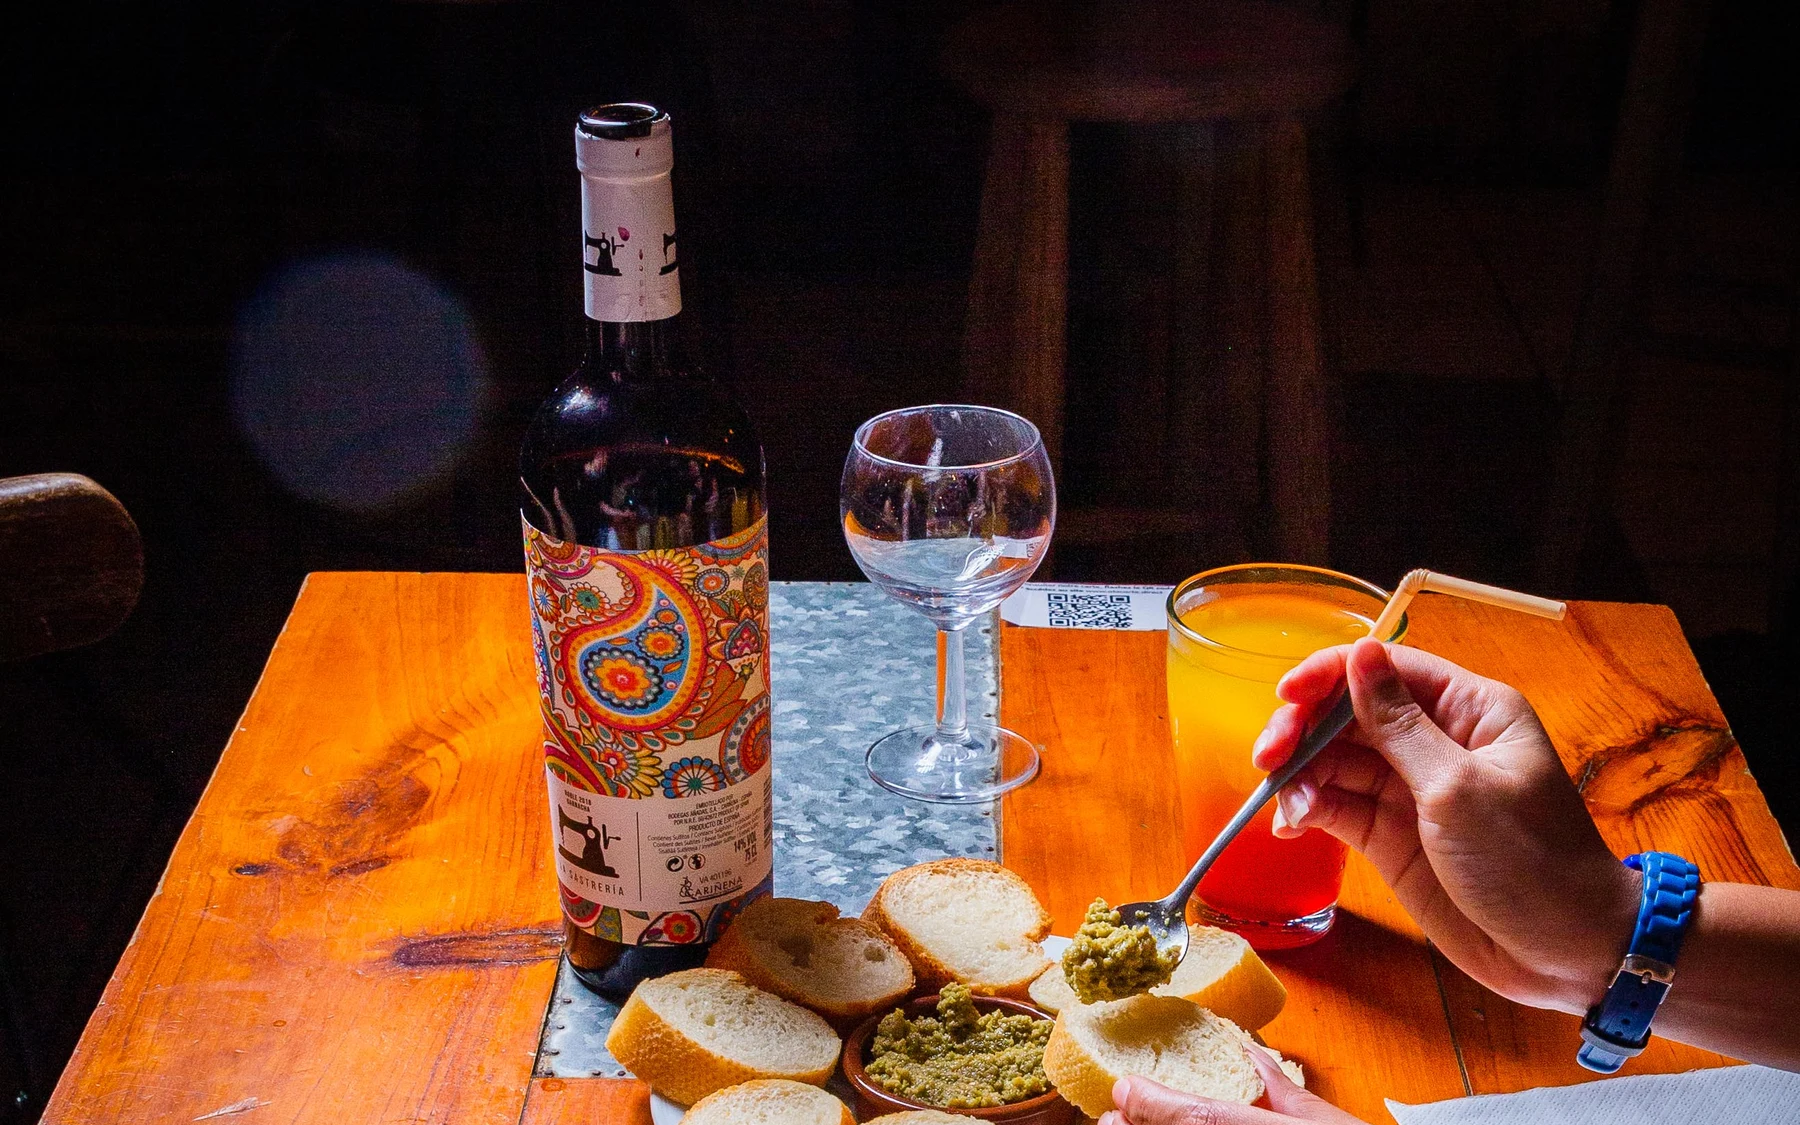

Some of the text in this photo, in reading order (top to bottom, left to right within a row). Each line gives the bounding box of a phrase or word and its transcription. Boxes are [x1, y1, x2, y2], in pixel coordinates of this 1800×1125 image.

[668, 811, 690, 820] BODEGAS
[689, 820, 717, 831] PRODUCTO
[717, 818, 724, 826] DE
[569, 869, 625, 896] SASTRERÍA
